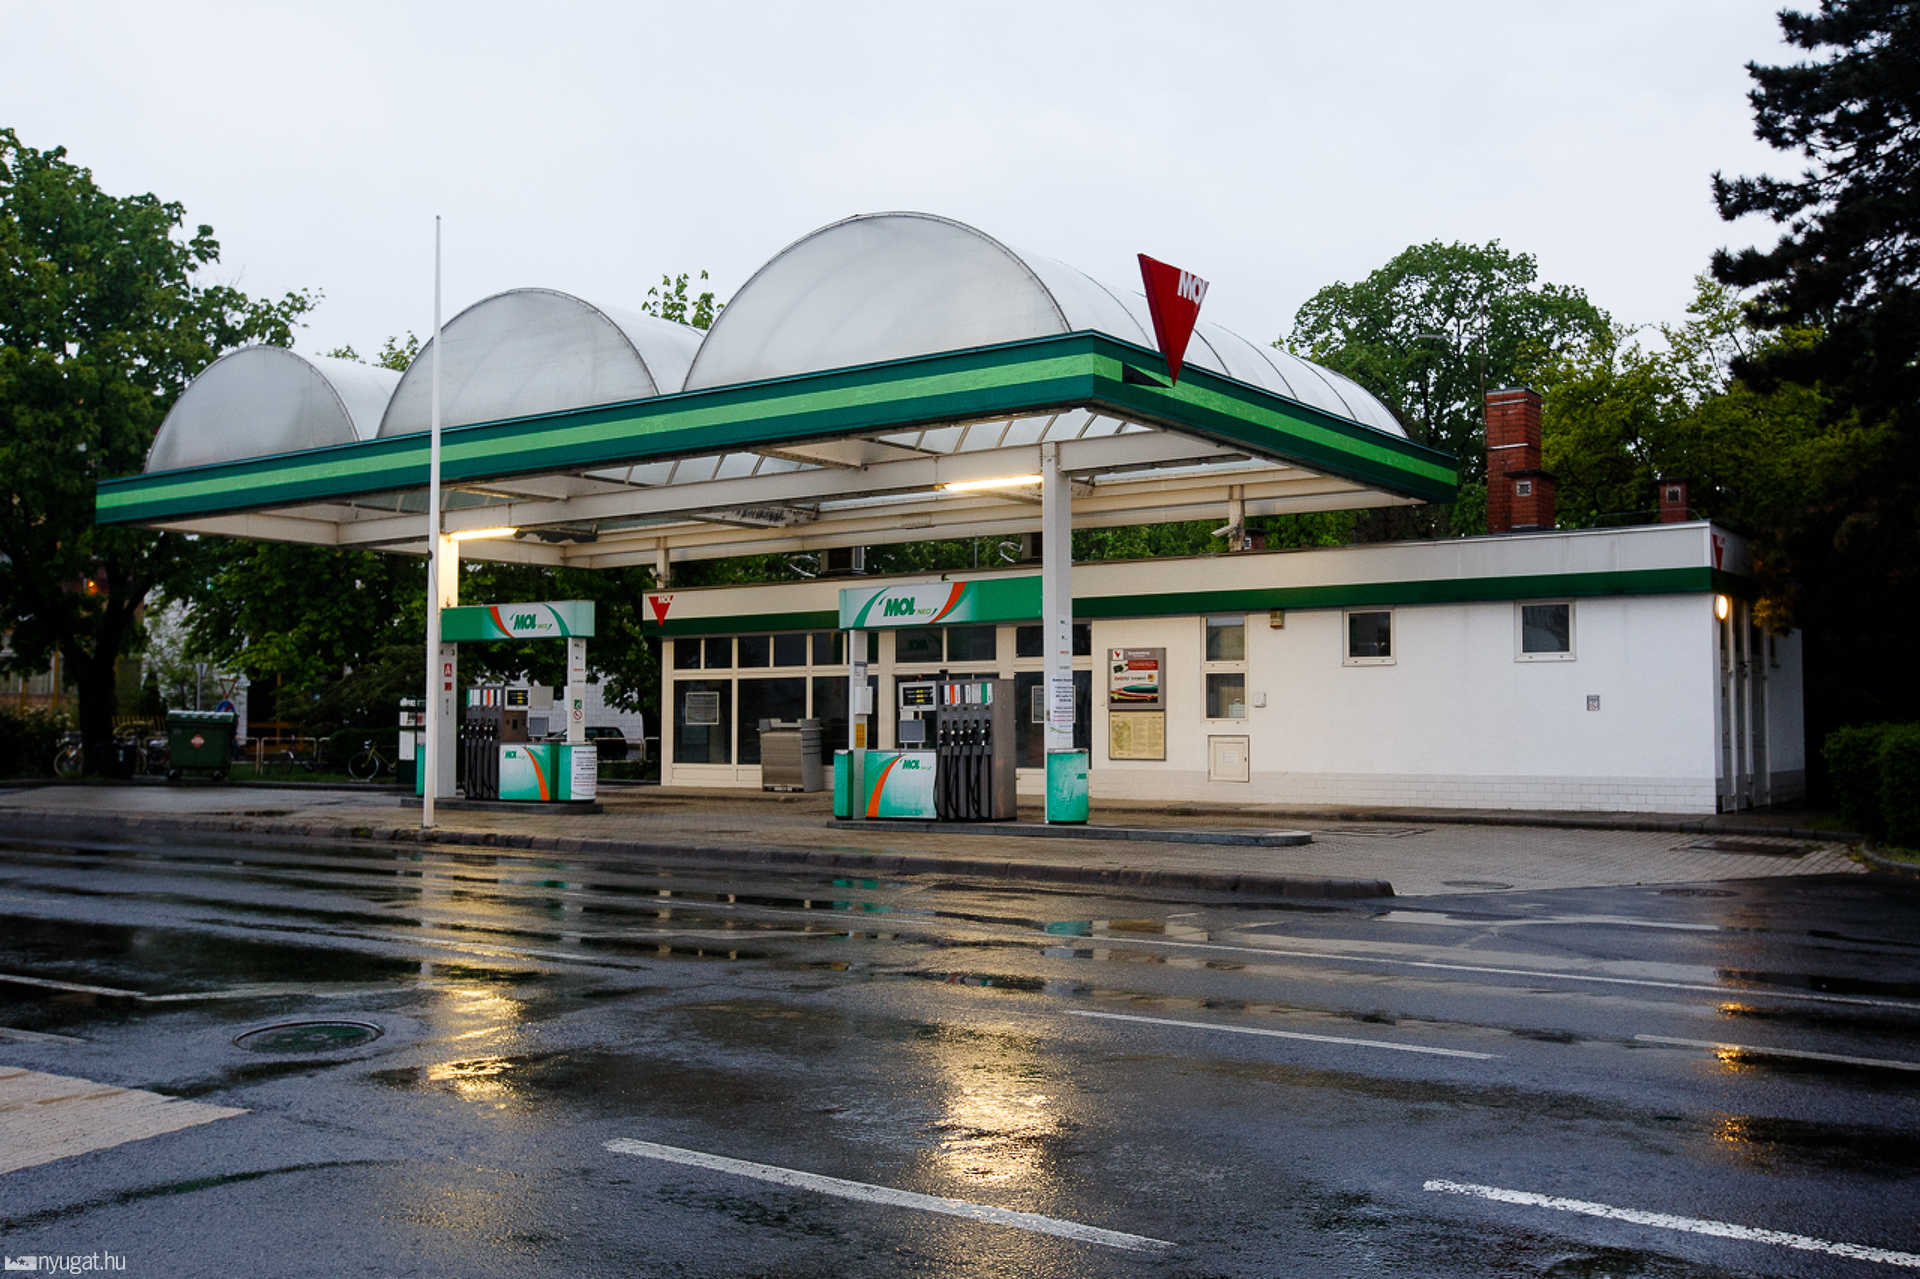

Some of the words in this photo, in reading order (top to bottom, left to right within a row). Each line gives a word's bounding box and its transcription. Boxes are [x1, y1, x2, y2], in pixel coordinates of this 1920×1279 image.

[1177, 269, 1209, 304] MOL
[883, 597, 915, 616] MOL
[513, 614, 536, 630] MOL
[902, 760, 920, 769] MOL
